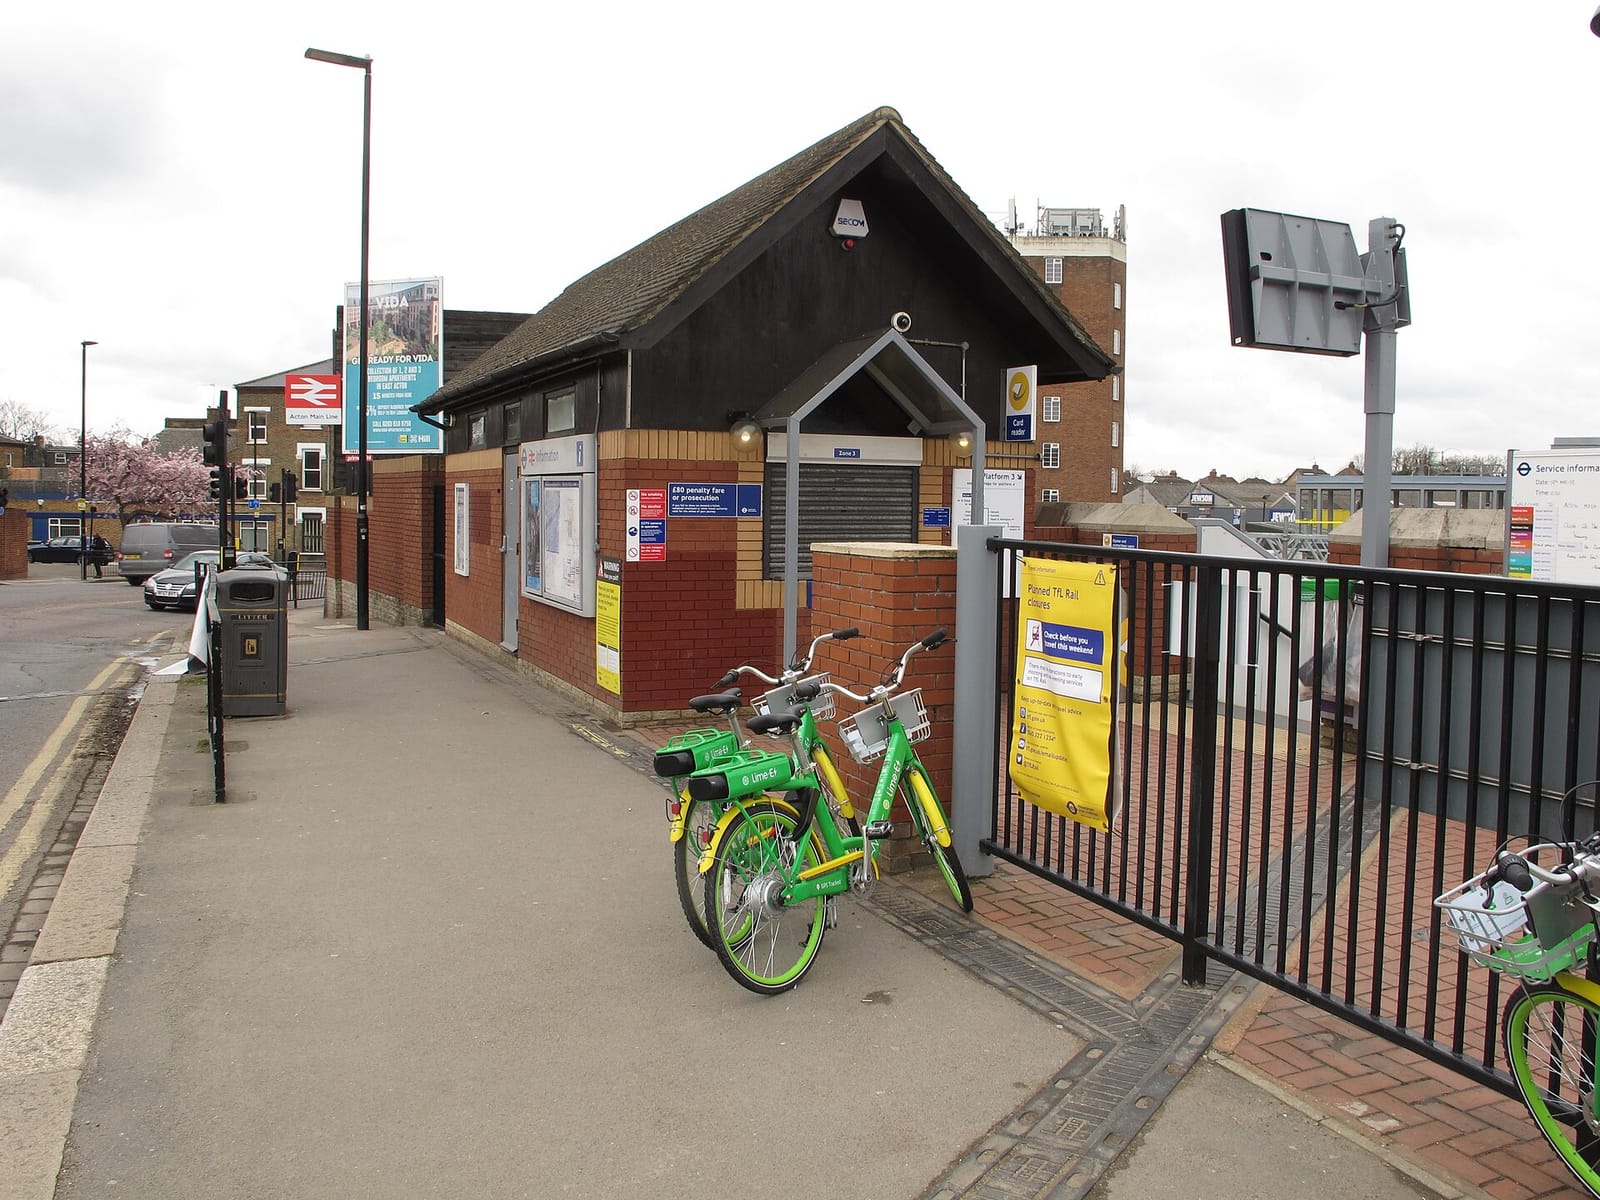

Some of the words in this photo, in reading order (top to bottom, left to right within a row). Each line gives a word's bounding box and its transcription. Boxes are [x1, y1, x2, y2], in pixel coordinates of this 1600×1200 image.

[838, 217, 865, 227] SECOM
[376, 295, 409, 308] VIDA
[368, 355, 394, 363] READY
[395, 354, 412, 362] FOR
[412, 353, 434, 362] VIDA
[1012, 419, 1024, 427] Card
[1010, 428, 1026, 436] reader
[418, 434, 430, 443] Hill
[1536, 464, 1565, 472] Service
[686, 487, 710, 495] penalty
[604, 559, 620, 573] WARNING
[1053, 587, 1063, 598] TfL
[1065, 589, 1079, 600] Rail
[1027, 598, 1050, 610] closures
[1044, 631, 1058, 640] Check
[1060, 633, 1077, 644] before
[1078, 638, 1089, 646] you
[1057, 643, 1068, 651] this
[1069, 646, 1094, 655] weekend
[1066, 679, 1083, 687] services
[1067, 708, 1082, 716] advice
